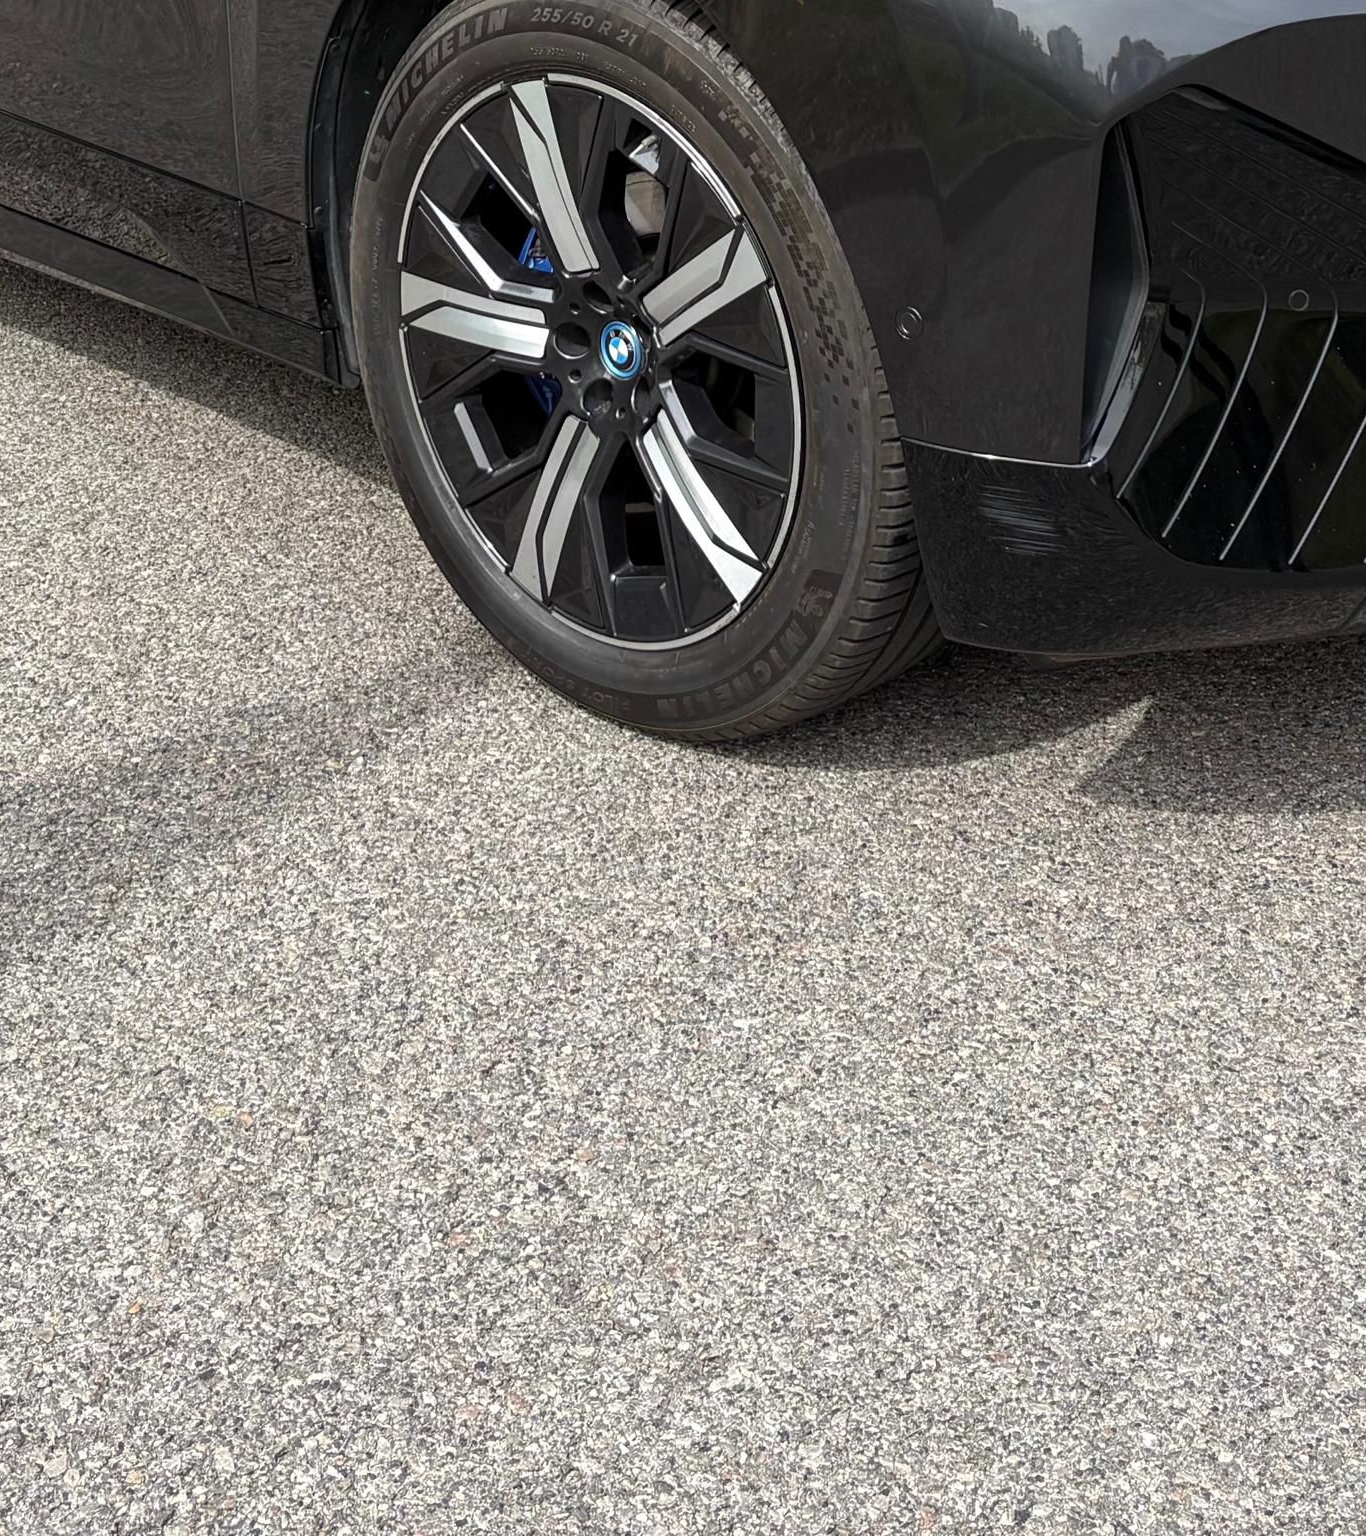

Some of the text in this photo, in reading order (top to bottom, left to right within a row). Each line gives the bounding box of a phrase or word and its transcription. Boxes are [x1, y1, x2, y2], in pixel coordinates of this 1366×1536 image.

[384, 7, 508, 132] MICHELIN
[530, 7, 639, 47] 255/50 R 21
[656, 618, 808, 719] MICHELIN
